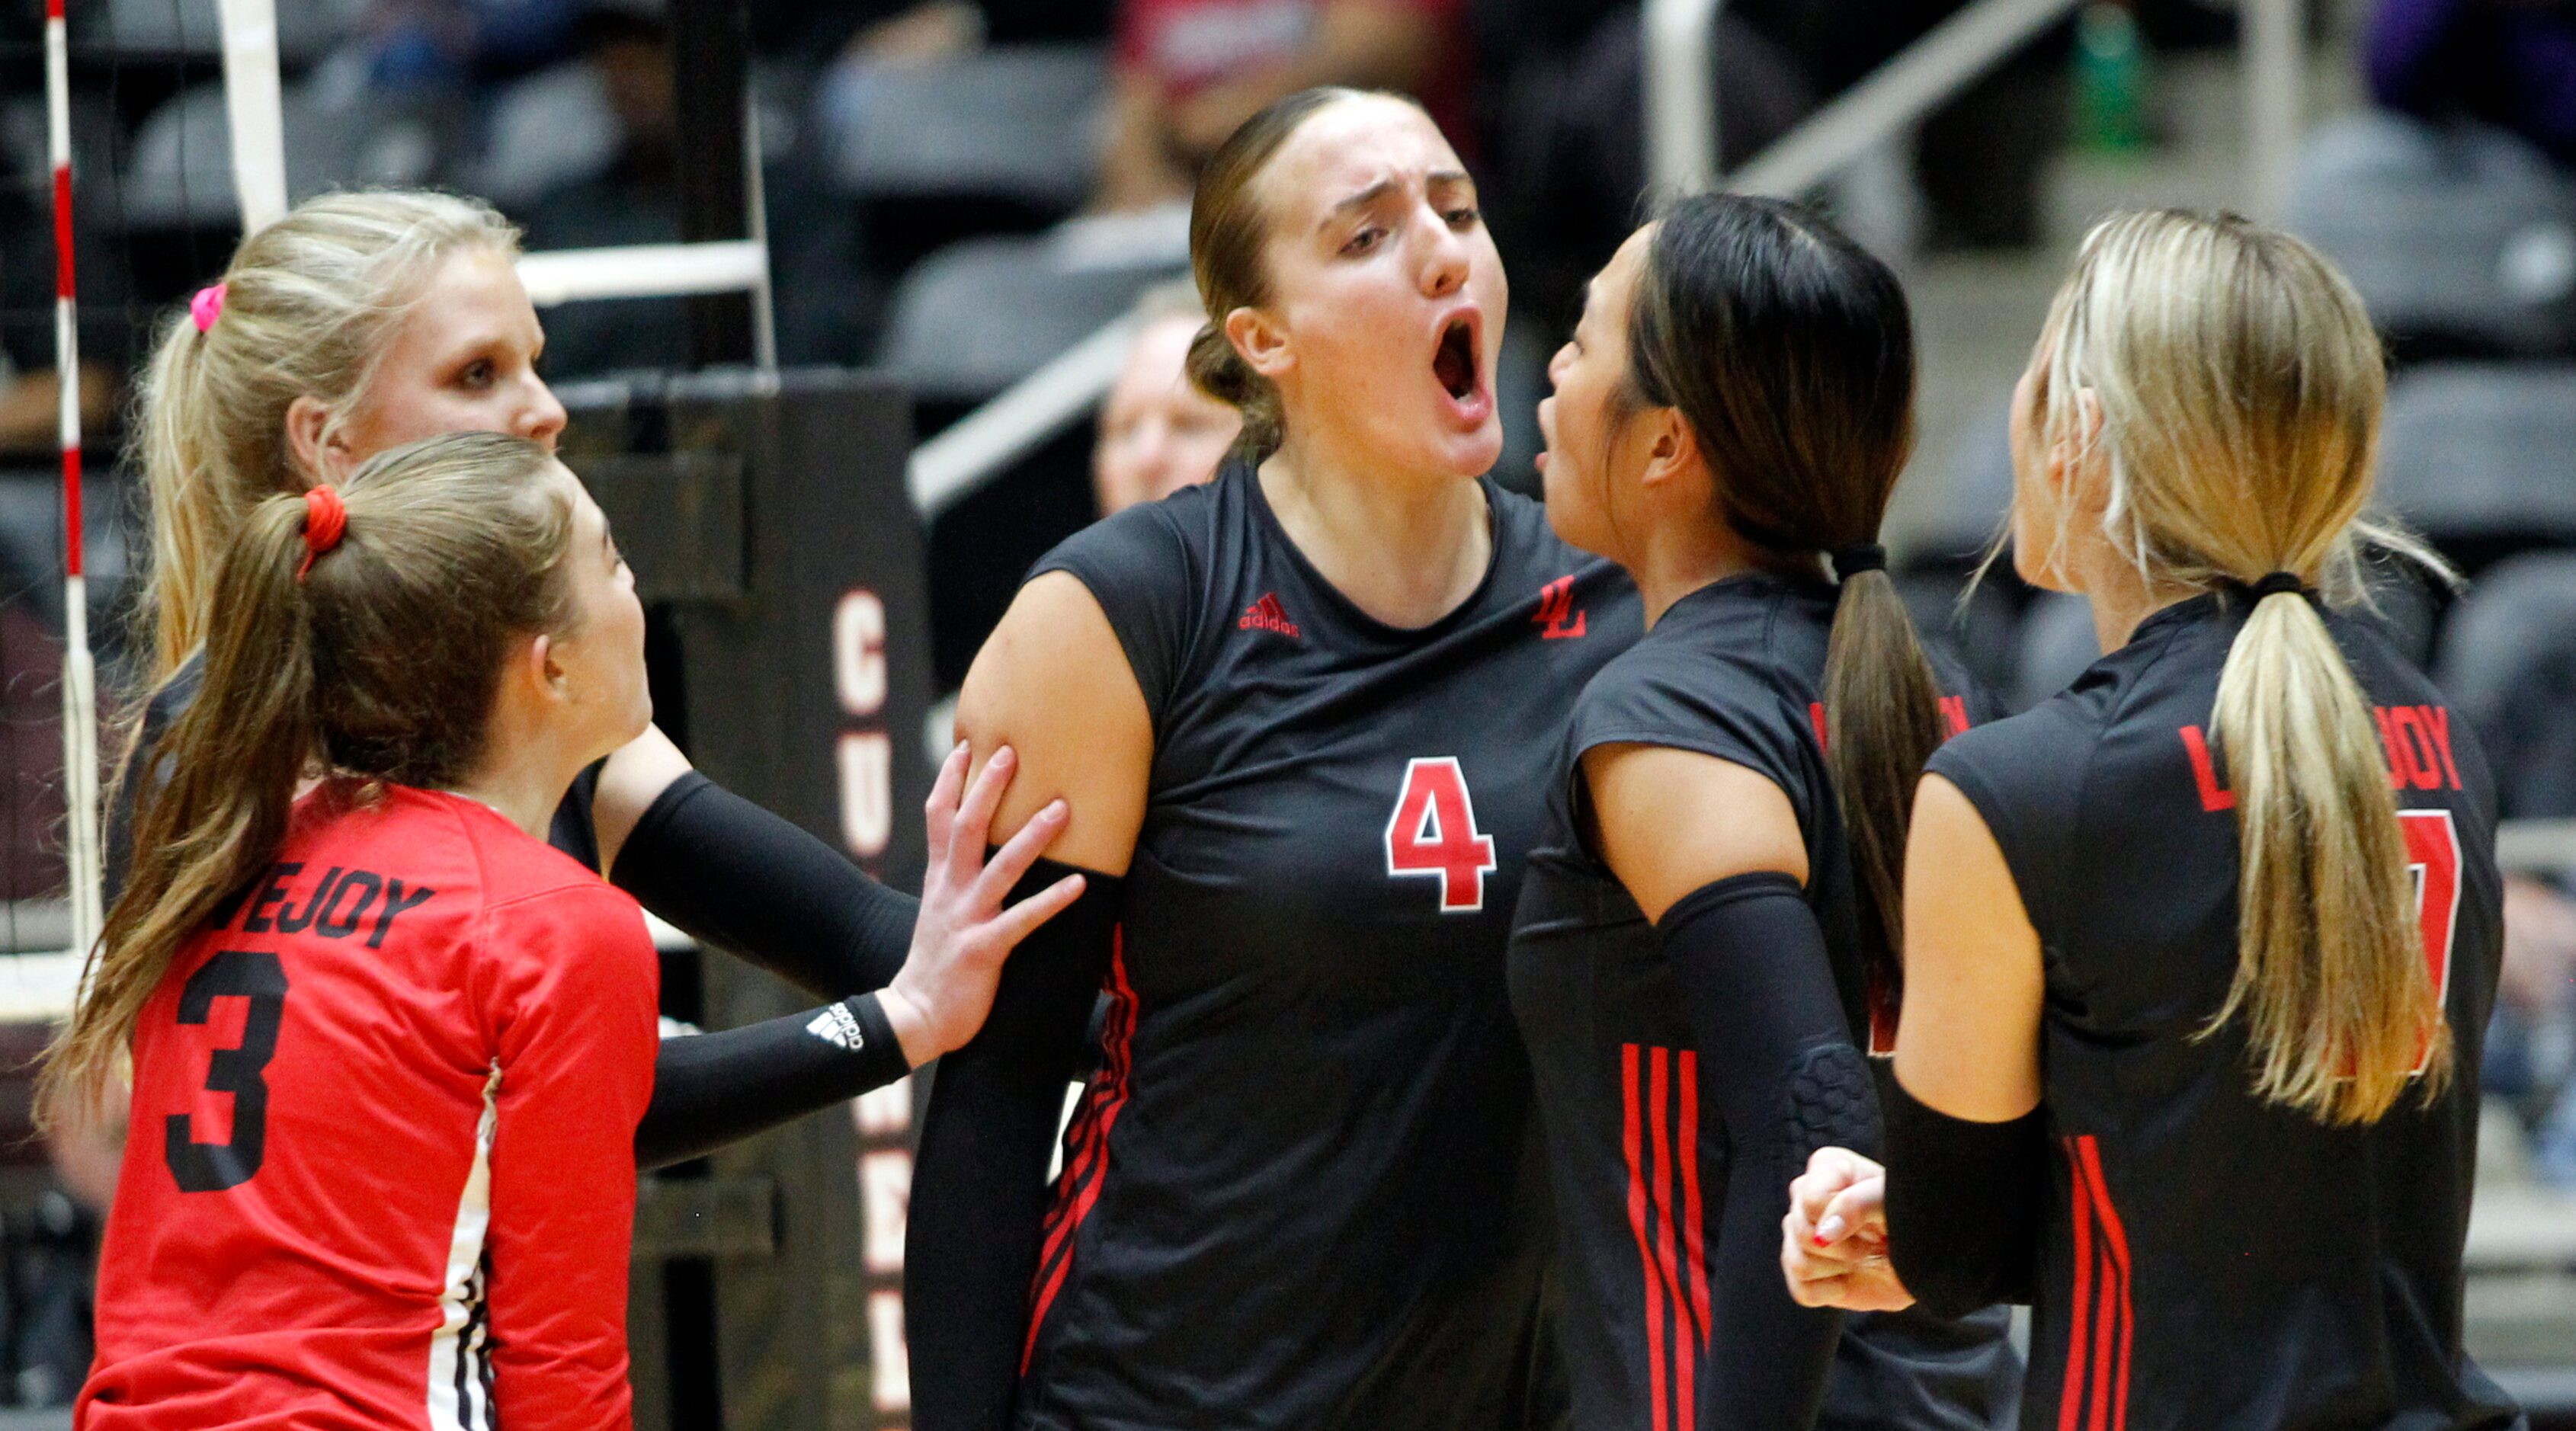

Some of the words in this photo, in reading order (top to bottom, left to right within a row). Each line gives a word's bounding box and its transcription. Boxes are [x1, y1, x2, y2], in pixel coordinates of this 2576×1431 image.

[1238, 611, 1301, 639] adidas
[2178, 704, 2462, 812] LJOY
[1384, 757, 1497, 912] 4
[164, 950, 290, 1193] 3
[828, 1001, 864, 1049] adidas
